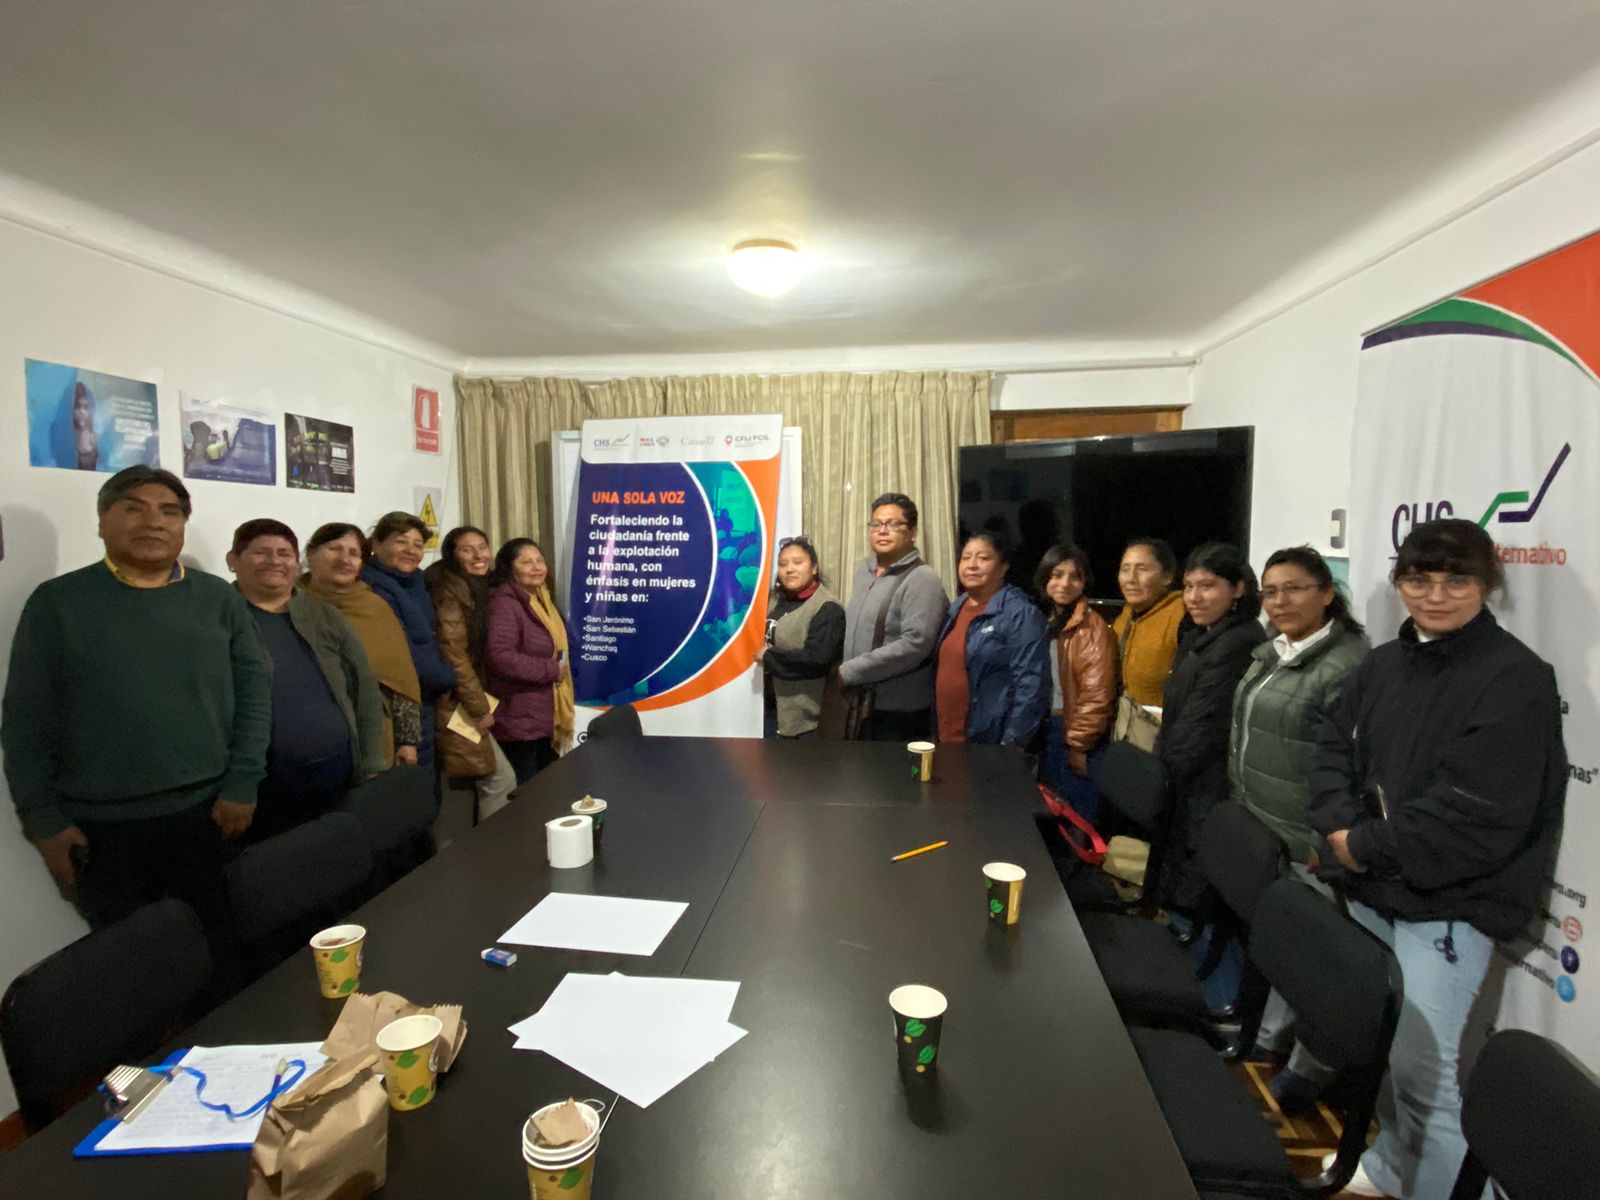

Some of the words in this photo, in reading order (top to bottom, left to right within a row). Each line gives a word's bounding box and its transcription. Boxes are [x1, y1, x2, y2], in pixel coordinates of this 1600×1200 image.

[592, 491, 619, 504] UNA
[623, 491, 656, 504] SOLA
[659, 491, 685, 504] VOZ
[590, 514, 670, 526] Fortaleciendo
[672, 515, 683, 526] la
[589, 529, 654, 541] ciudadanía
[655, 530, 690, 541] frente
[588, 547, 595, 555] a
[599, 544, 609, 555] la
[613, 545, 679, 559] explotación
[587, 560, 638, 573] humana,
[641, 562, 662, 572] con
[586, 575, 629, 587] énfasis
[632, 578, 647, 587] en
[649, 577, 696, 590] mujeres
[585, 591, 593, 603] y
[596, 590, 628, 602] niñas
[631, 593, 649, 602] en:
